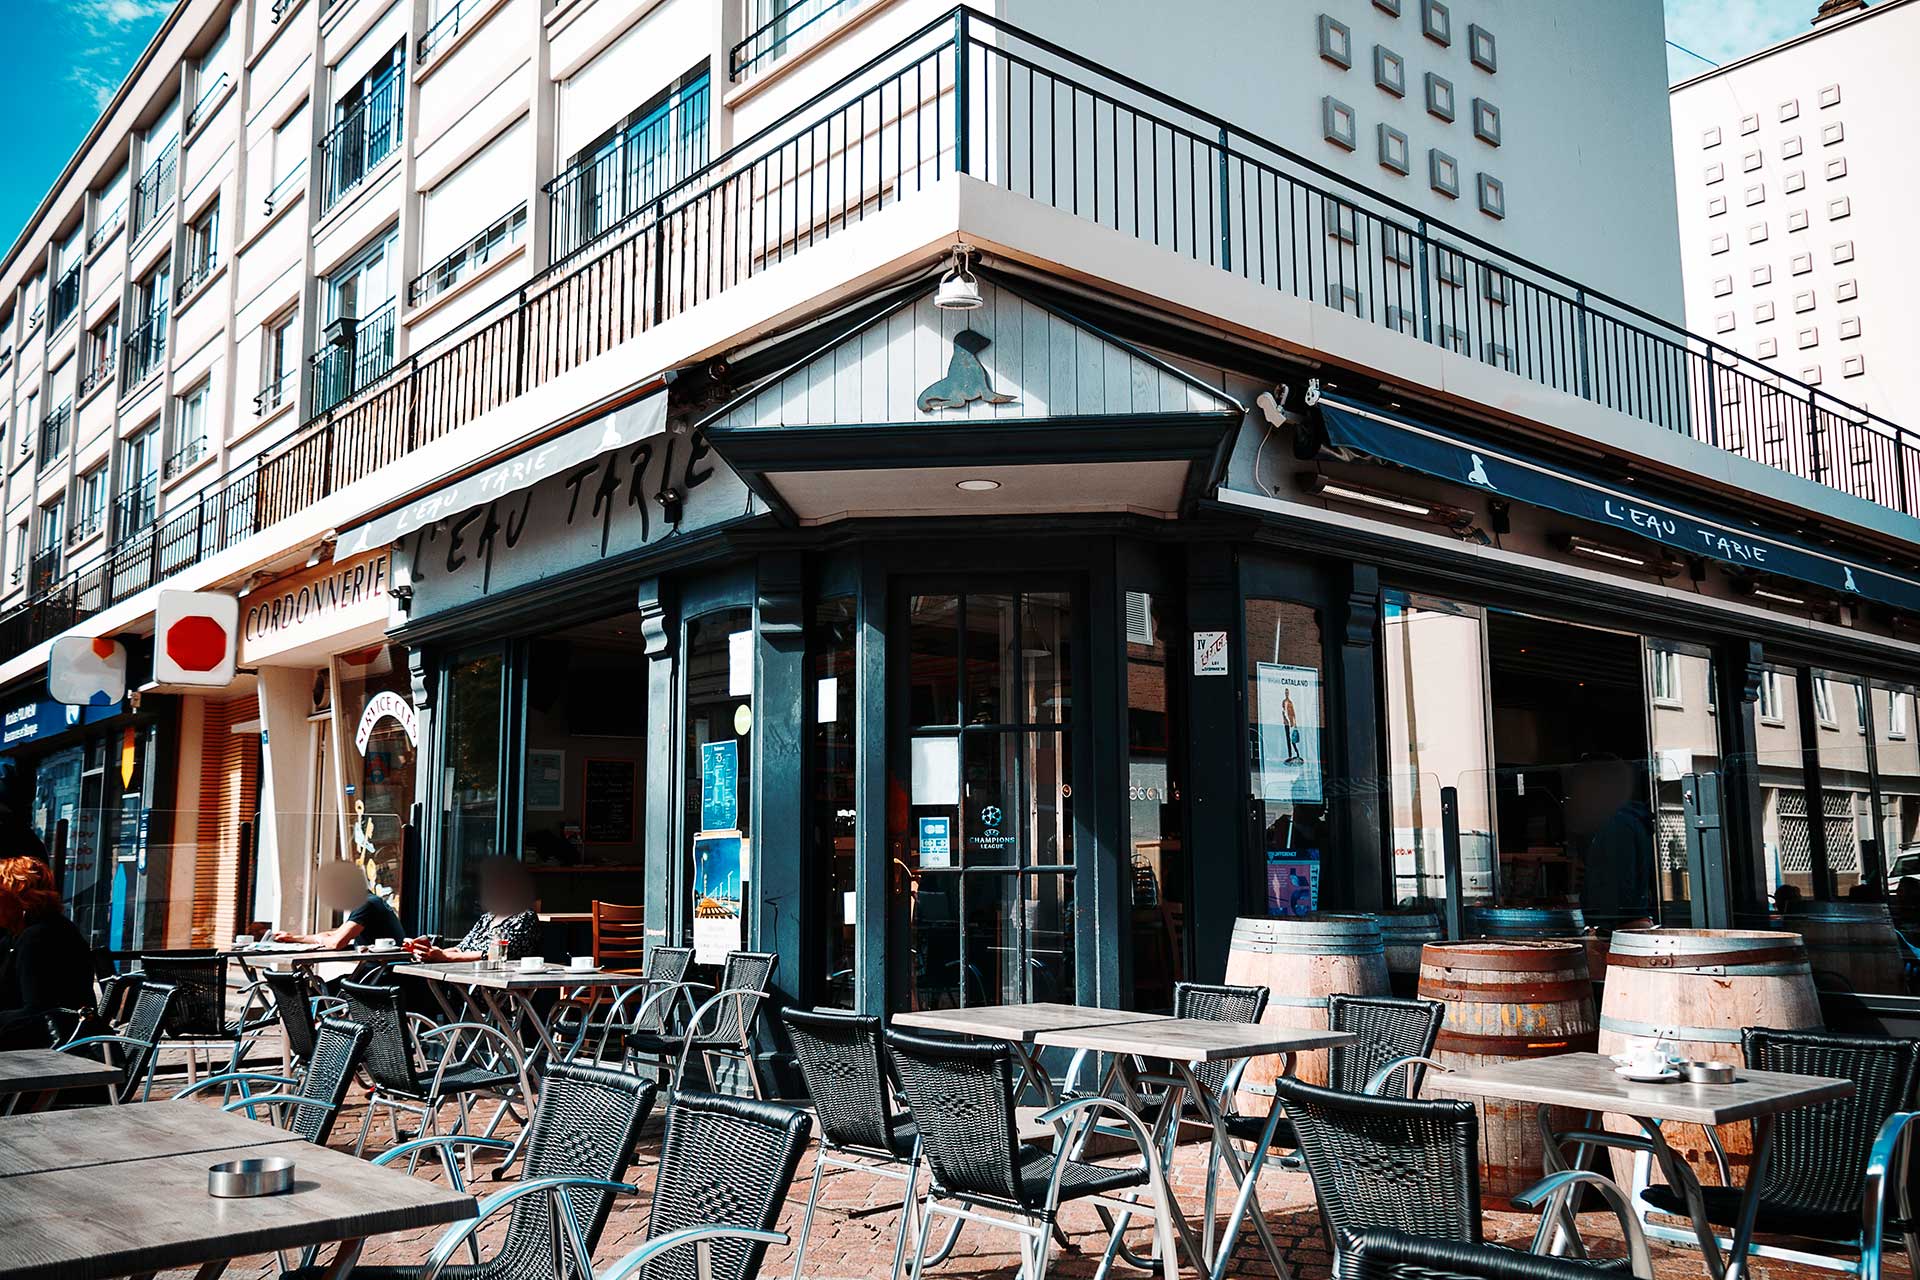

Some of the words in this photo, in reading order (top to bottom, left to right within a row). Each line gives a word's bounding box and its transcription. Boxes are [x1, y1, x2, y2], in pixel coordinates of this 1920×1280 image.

[396, 490, 458, 530] L'EAU
[479, 445, 558, 493] TARIE
[410, 490, 533, 595] L'EAU
[565, 426, 715, 558] TARIE
[1604, 500, 1676, 538] L'EAU
[1697, 529, 1767, 562] TARIE
[246, 555, 387, 642] CORDONNERIE
[969, 836, 1016, 844] CHAMPIONS
